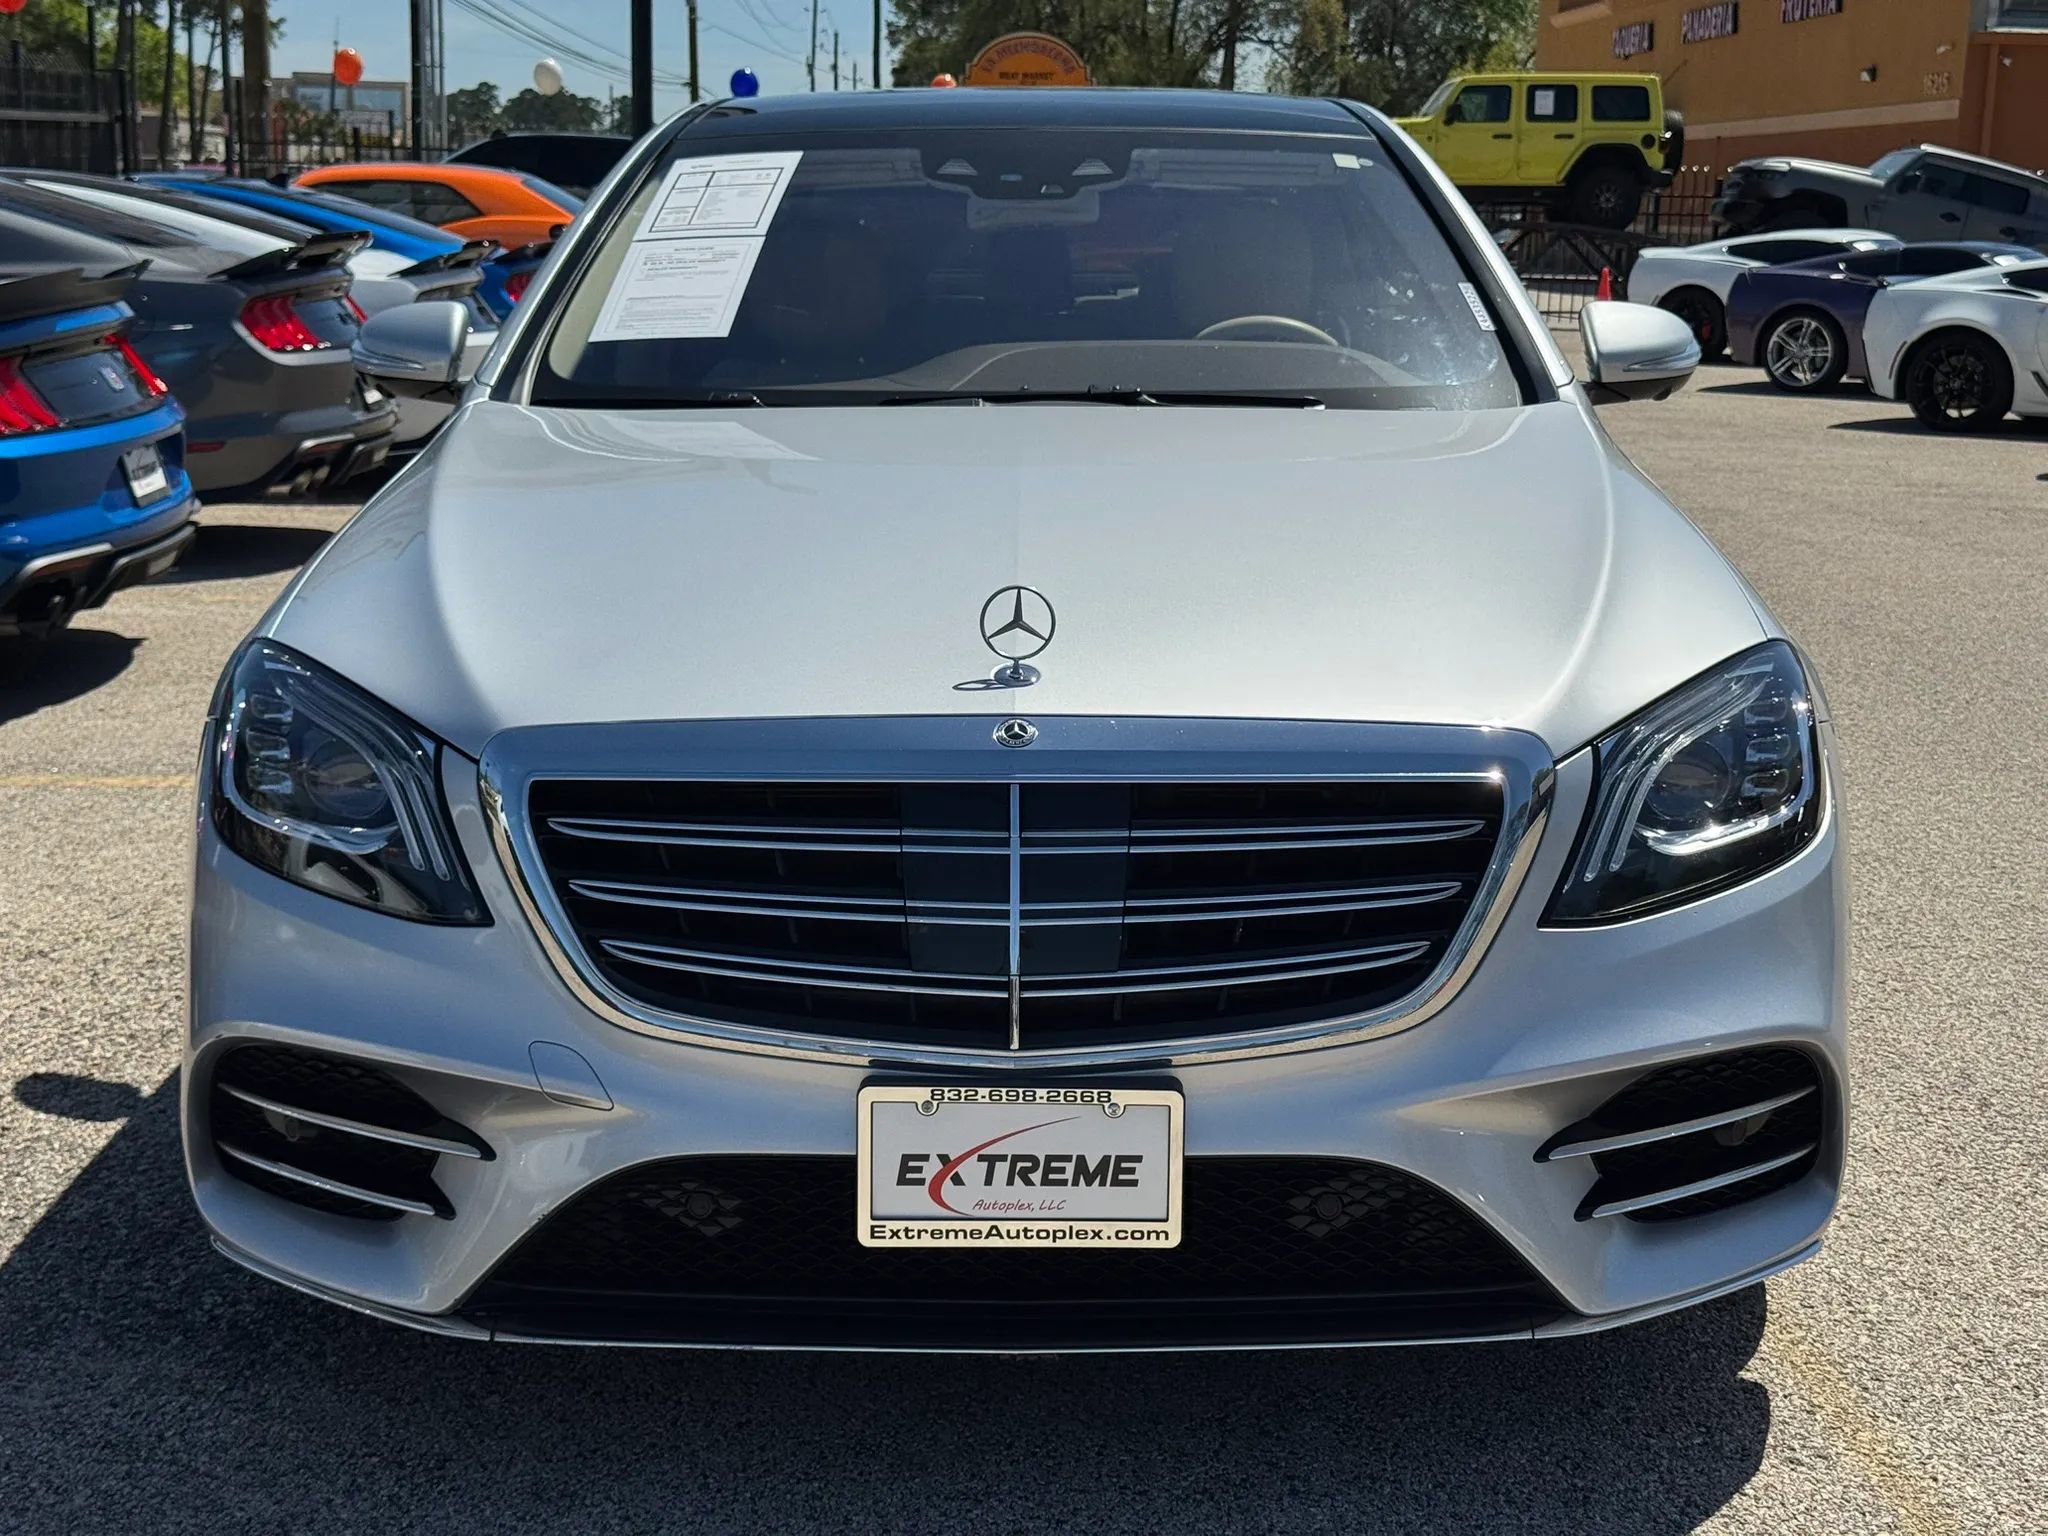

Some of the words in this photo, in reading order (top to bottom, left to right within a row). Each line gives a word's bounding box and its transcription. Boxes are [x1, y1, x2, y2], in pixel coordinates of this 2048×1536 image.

[930, 1088, 1112, 1103] 832-698-2668
[896, 1152, 1143, 1188] EXTREME
[972, 1199, 1035, 1214] Autoplex,
[1039, 1199, 1066, 1211] LLC
[869, 1224, 1169, 1243] ExtremeAutoplex.com
